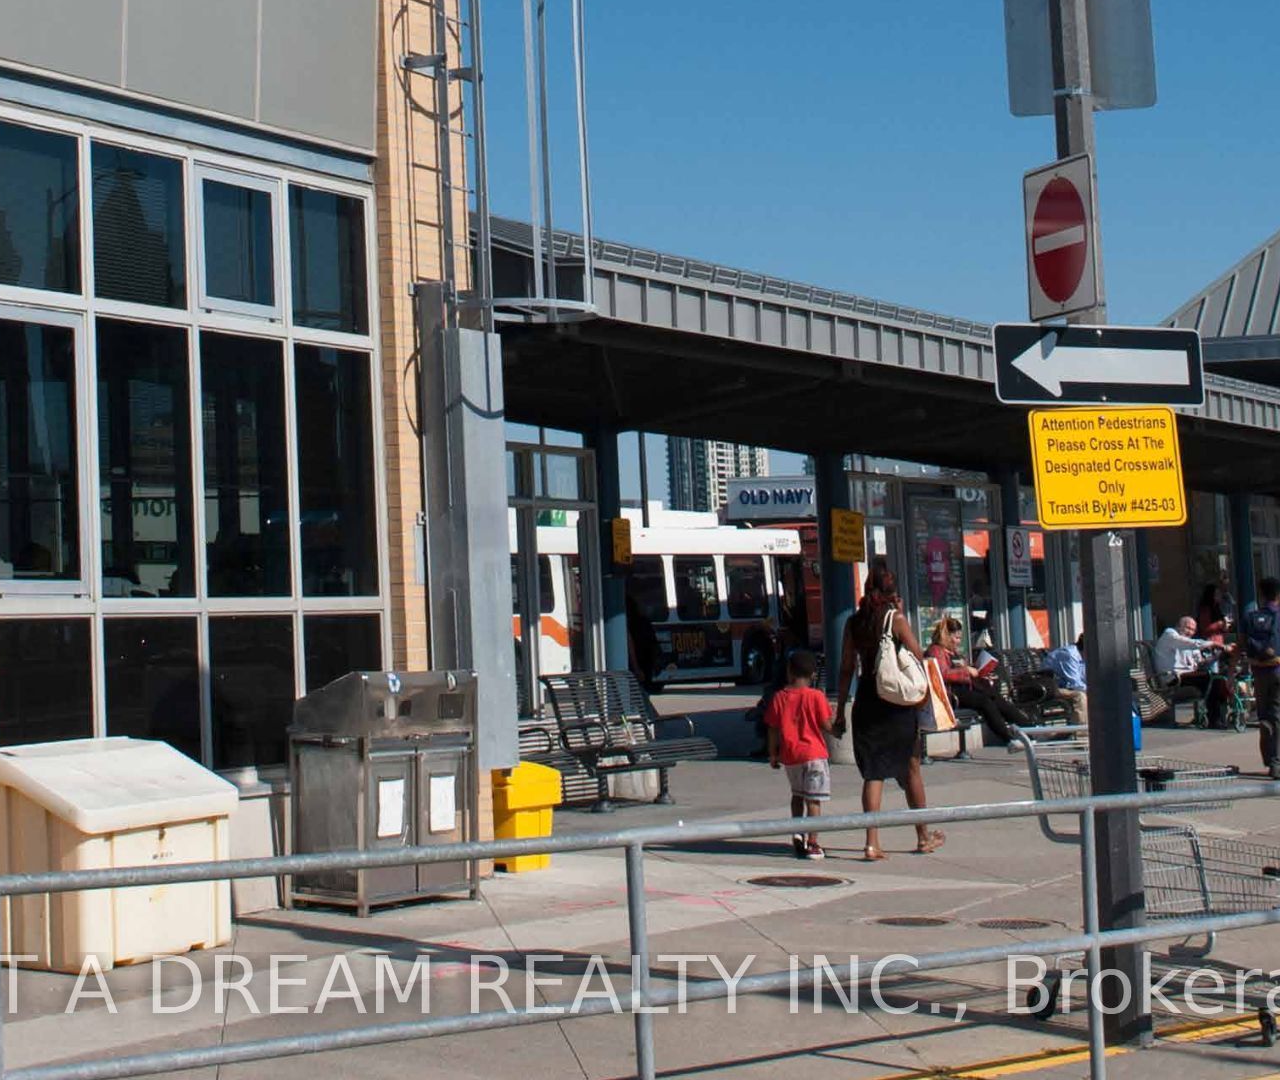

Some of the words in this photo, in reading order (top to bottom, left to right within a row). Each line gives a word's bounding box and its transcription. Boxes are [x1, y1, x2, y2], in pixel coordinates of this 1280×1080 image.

[1041, 418, 1095, 431] Attention
[1098, 416, 1166, 430] Pedestrians
[1047, 438, 1086, 452] Please
[1089, 437, 1124, 451] Cross
[1127, 437, 1139, 450] At
[1143, 436, 1165, 449] The
[1045, 459, 1111, 476] Designated
[1114, 458, 1175, 472] Crosswalk
[1098, 480, 1125, 496] Only
[739, 489, 770, 505] OLD
[773, 488, 814, 505] NAVY
[1048, 500, 1089, 515] Transit
[1092, 500, 1127, 517] Bylaw
[1131, 498, 1176, 512] #425-03
